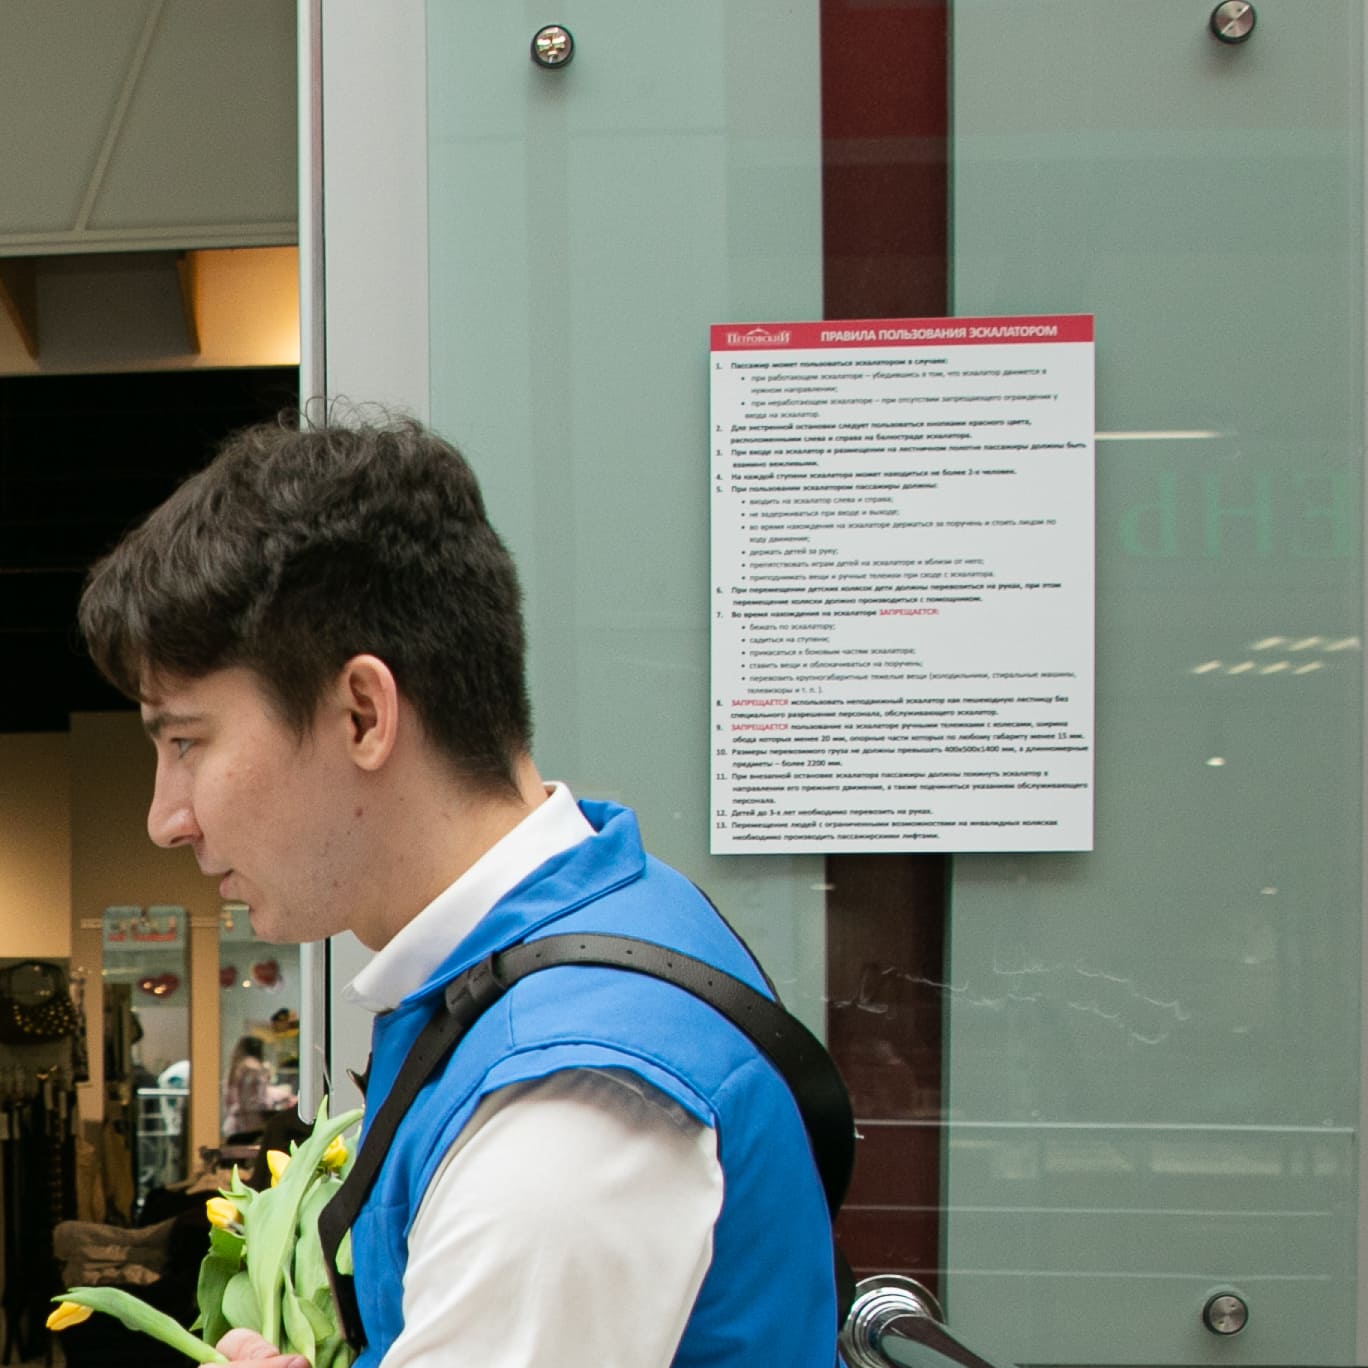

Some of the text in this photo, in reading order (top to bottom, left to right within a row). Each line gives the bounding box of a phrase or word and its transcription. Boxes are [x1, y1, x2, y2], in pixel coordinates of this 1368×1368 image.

[821, 325, 1058, 343] ПРАВИЛА ПОЛЬЗОВАНИЯ ЭСКАЛАТОРОМ
